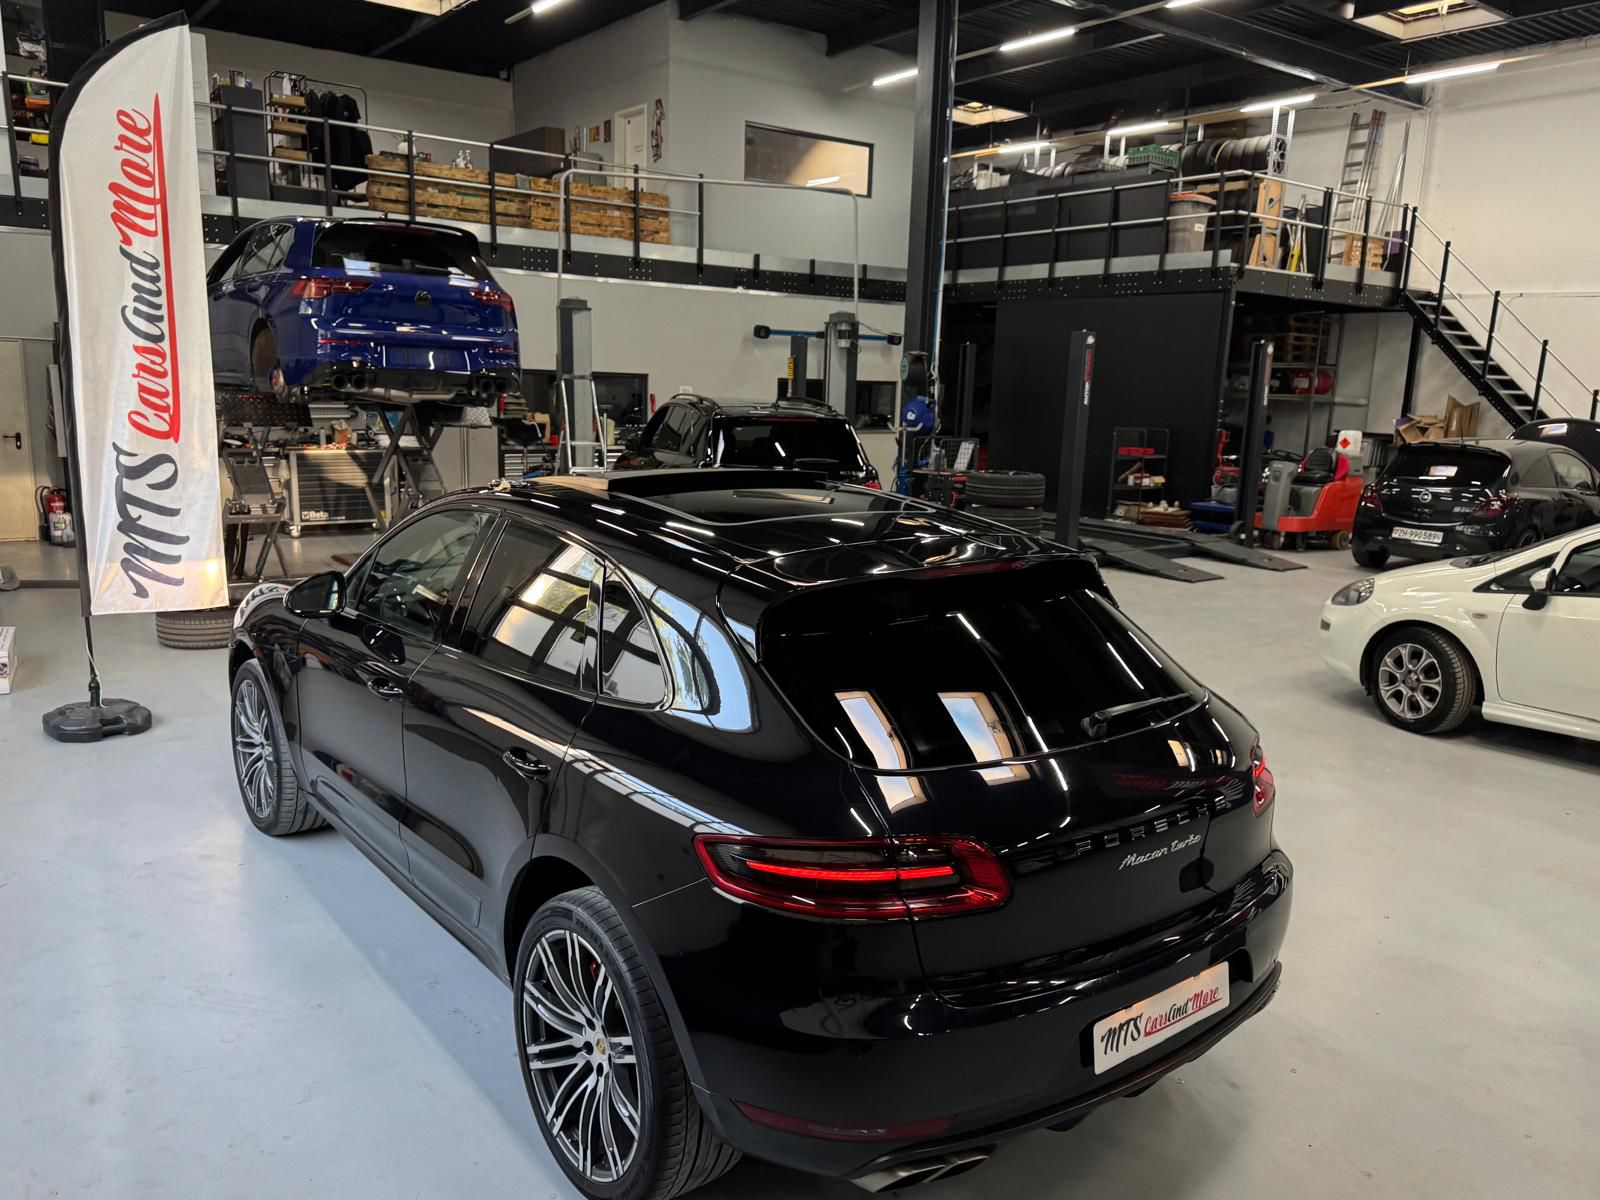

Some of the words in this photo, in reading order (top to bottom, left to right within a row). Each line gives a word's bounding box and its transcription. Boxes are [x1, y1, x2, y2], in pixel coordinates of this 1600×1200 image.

[112, 441, 190, 599] MTS
[1075, 796, 1227, 856] PORSCHE
[1118, 846, 1169, 871] Macan
[1171, 833, 1201, 852] turbo
[1100, 1012, 1143, 1056] MTS
